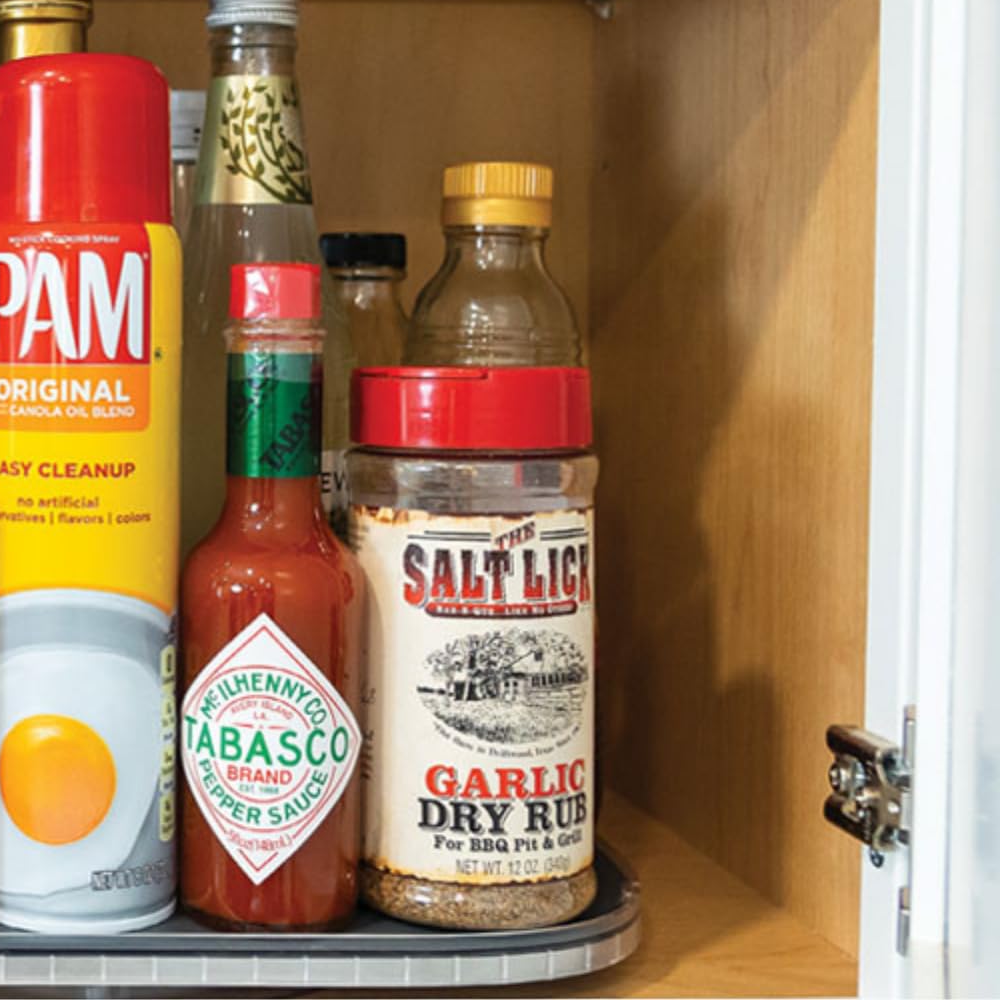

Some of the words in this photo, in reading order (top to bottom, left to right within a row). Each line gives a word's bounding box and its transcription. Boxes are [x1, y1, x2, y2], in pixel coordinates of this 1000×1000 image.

[9, 404, 63, 417] CANOLA
[66, 406, 89, 418] OIL
[92, 405, 136, 419] BLEND
[38, 462, 136, 479] CLEANUP
[17, 497, 34, 507] no
[38, 496, 100, 509] artificial
[58, 511, 104, 525] flavors
[115, 511, 151, 524] colors
[494, 521, 536, 551] THE
[402, 543, 514, 607] SALT
[522, 543, 591, 603] LICK
[184, 715, 350, 767] TABASCO
[226, 763, 293, 786] BRAND
[425, 759, 586, 800] GARLIC
[198, 758, 263, 825] PEPPER
[267, 770, 329, 825] SAUCE
[418, 798, 514, 835] DRY
[525, 791, 588, 832] RUB
[433, 835, 465, 851] For
[469, 837, 510, 854] BBQ
[514, 836, 539, 852] Pit
[542, 836, 555, 850] &
[557, 829, 584, 848] Grill
[456, 859, 479, 874] NET
[482, 860, 506, 876] WT.
[508, 860, 522, 874] 12
[524, 859, 539, 873] OZ
